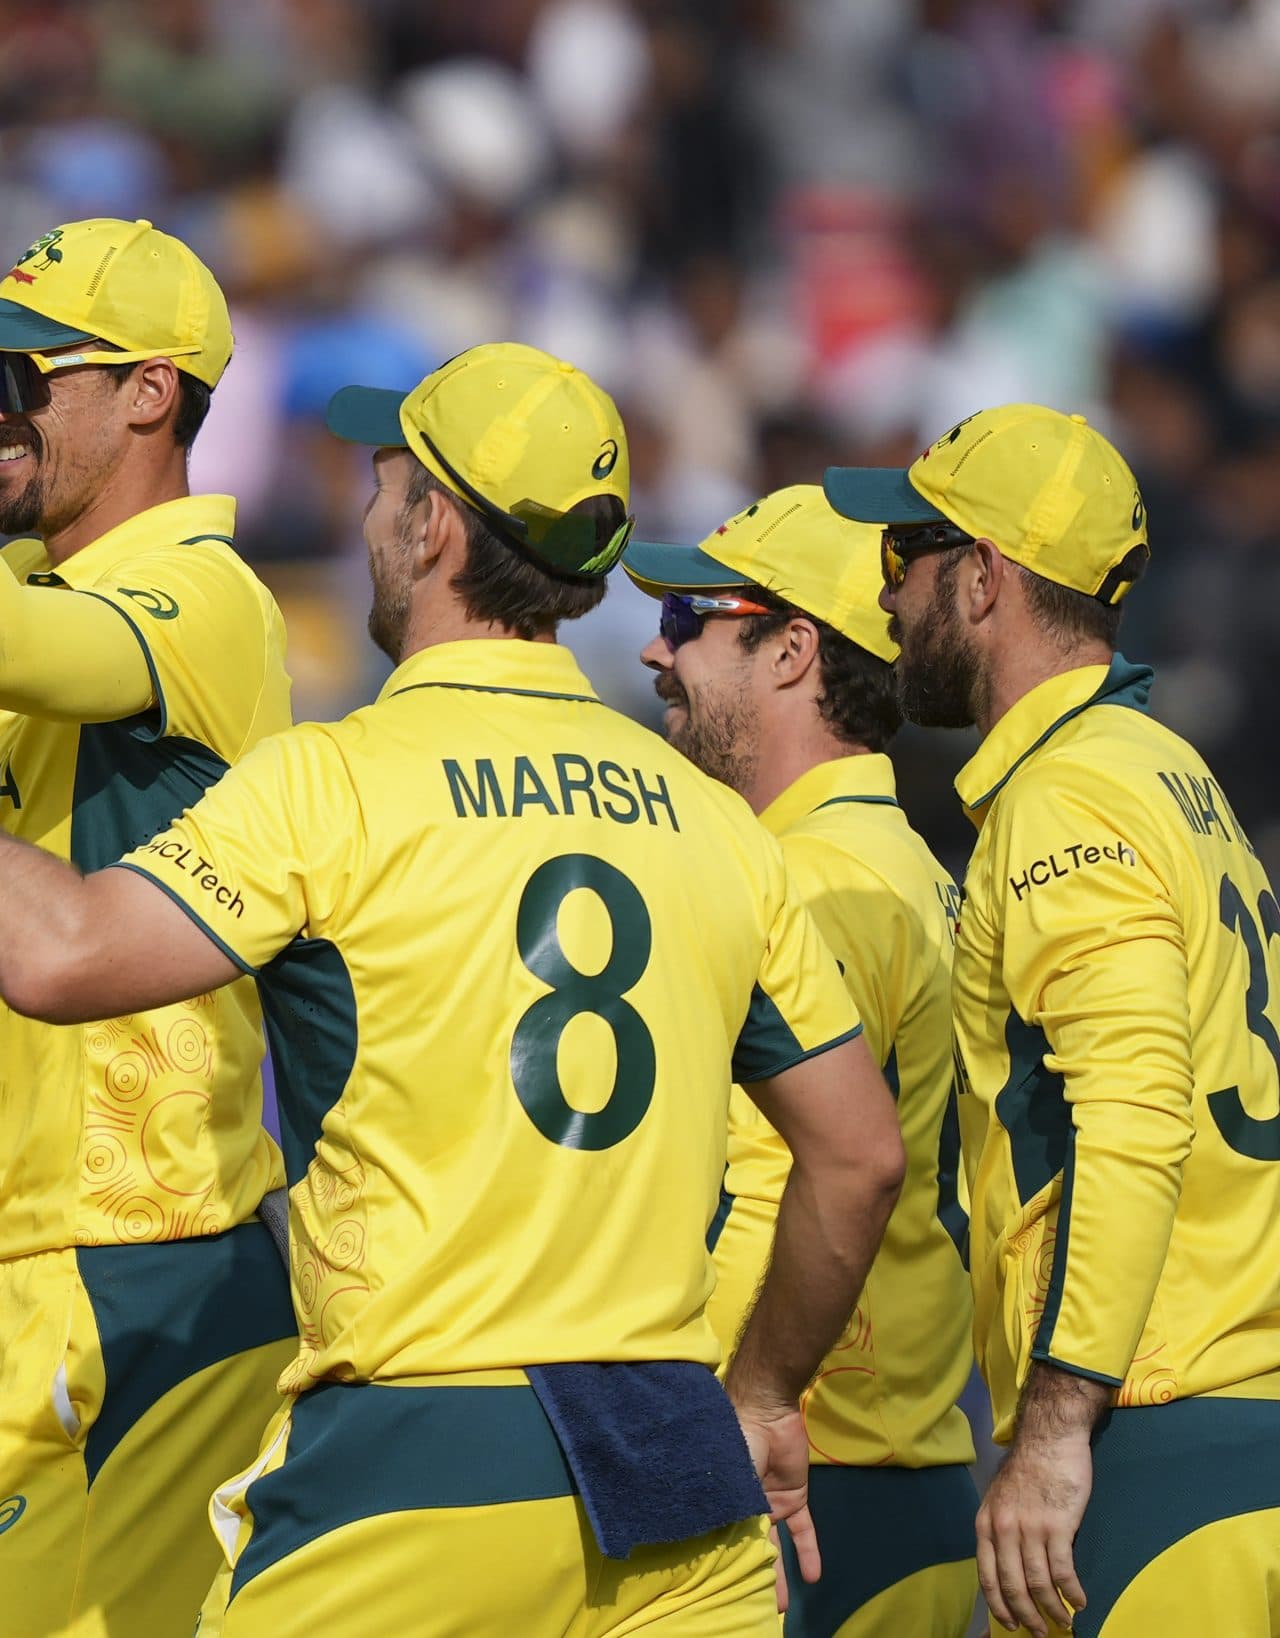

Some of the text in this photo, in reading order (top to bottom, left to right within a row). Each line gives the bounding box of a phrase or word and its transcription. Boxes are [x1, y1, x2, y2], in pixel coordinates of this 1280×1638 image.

[441, 753, 680, 833] MARSH
[139, 840, 245, 919] HCLTech
[1009, 841, 1135, 901] HCLTech
[510, 853, 656, 1151] 8
[1206, 872, 1280, 1161] 3
